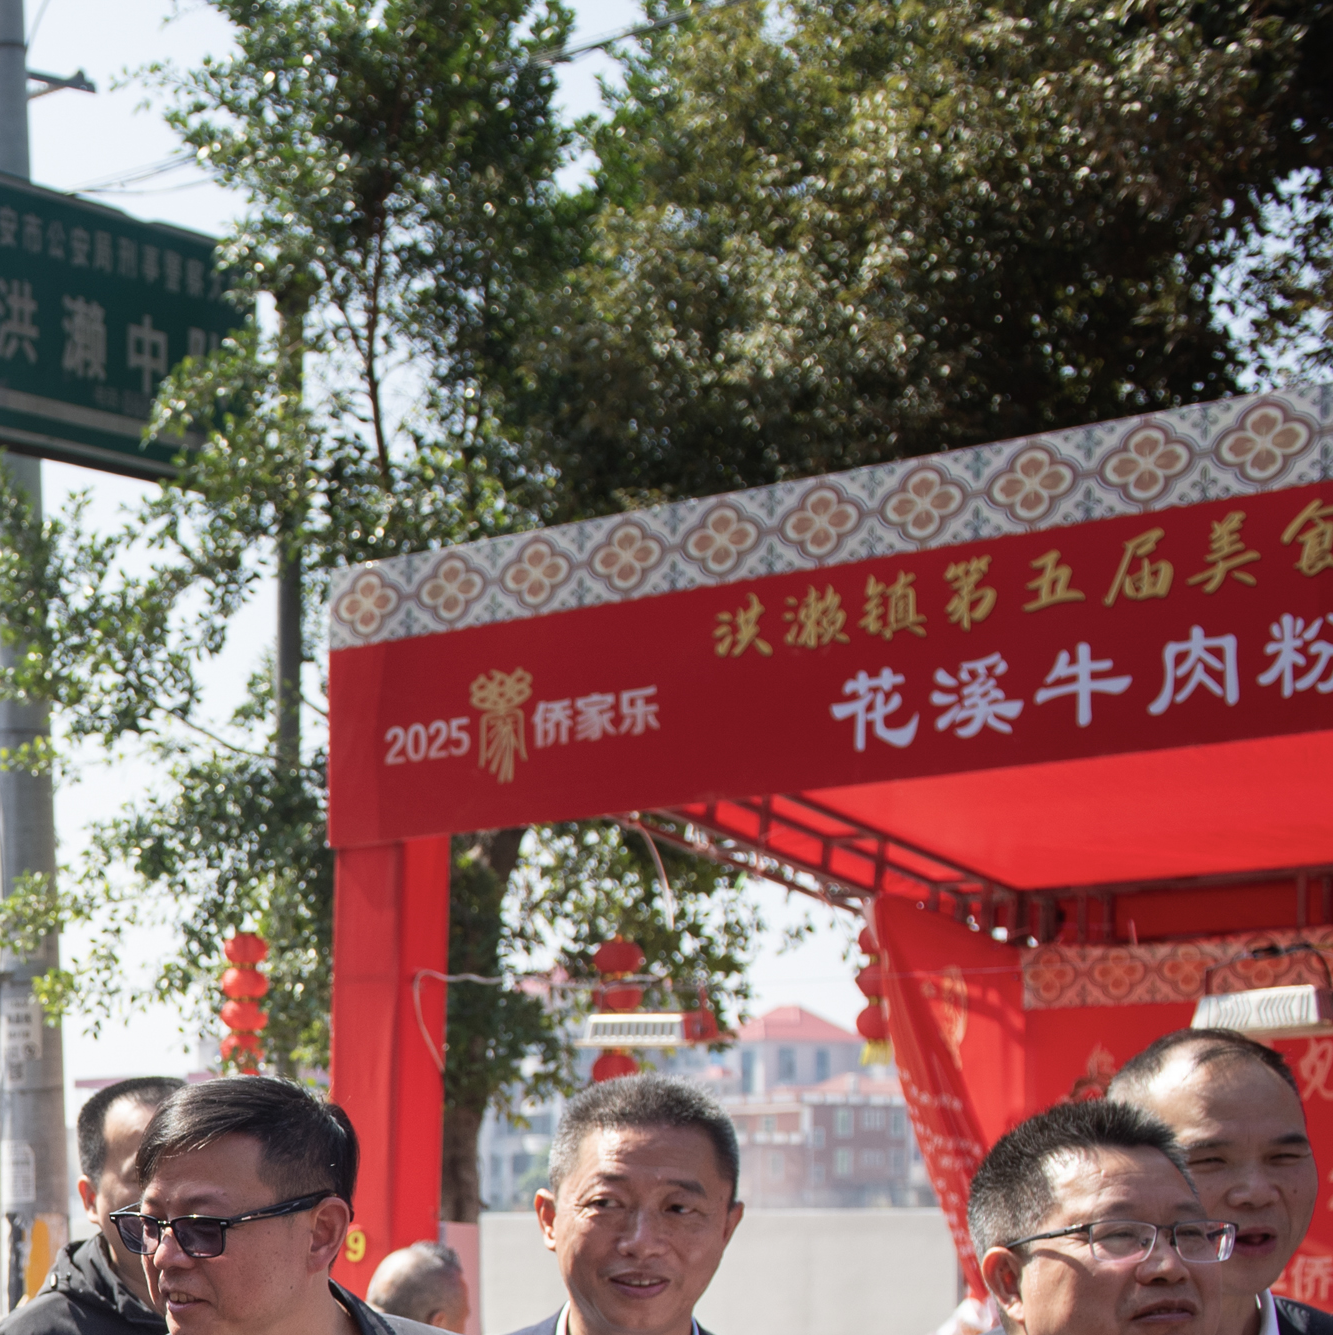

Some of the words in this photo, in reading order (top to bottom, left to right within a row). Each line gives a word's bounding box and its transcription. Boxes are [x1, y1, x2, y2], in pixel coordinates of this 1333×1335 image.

[713, 499, 1333, 658] 洪濑镇第五届美食
[384, 716, 471, 766] 2025
[532, 685, 661, 748] 侨家乐
[829, 613, 1333, 752] 花溪牛肉粉
